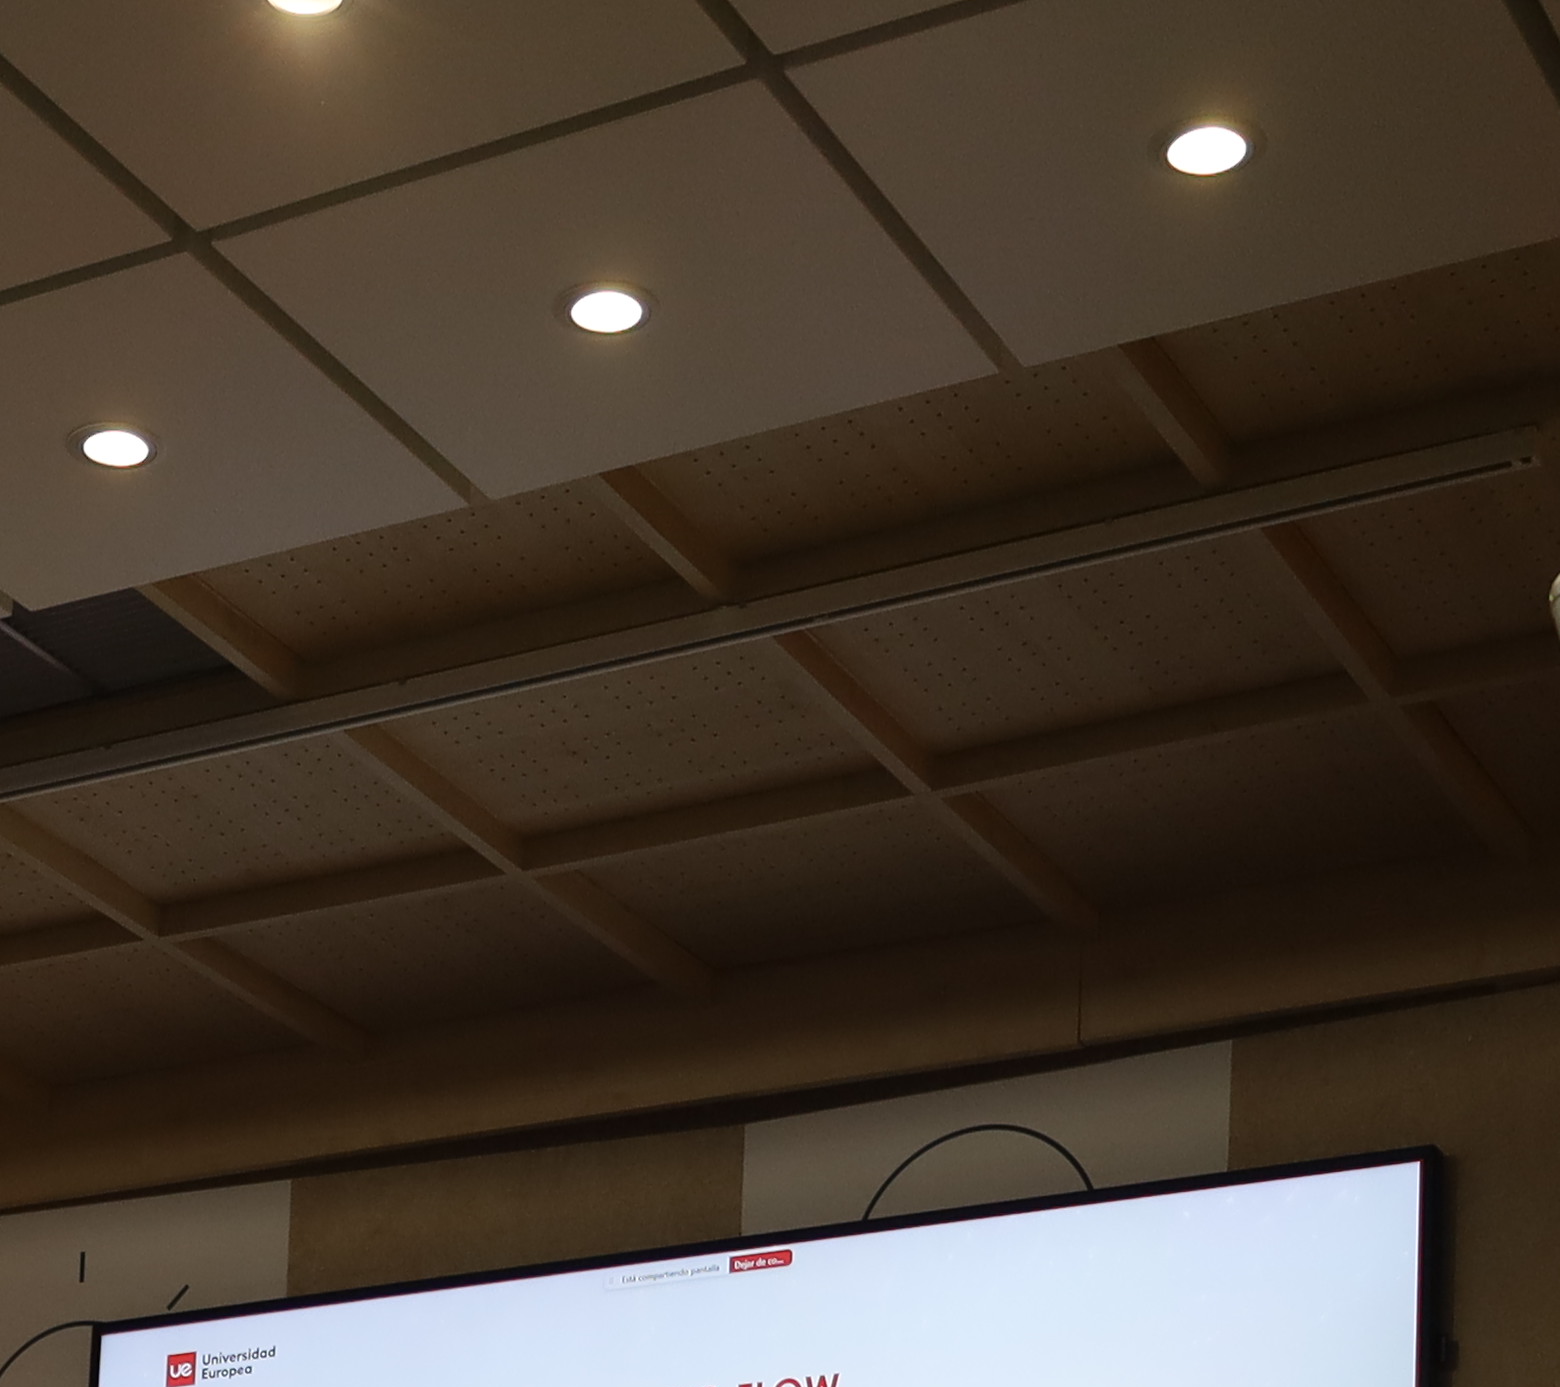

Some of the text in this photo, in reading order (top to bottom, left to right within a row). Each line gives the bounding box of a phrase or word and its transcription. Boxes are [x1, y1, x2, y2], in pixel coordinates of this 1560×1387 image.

[690, 1264, 720, 1277] pantalla
[734, 1258, 755, 1271] Dejar
[756, 1257, 766, 1267] de
[202, 1345, 276, 1366] Universidad
[202, 1365, 252, 1380] Europea
